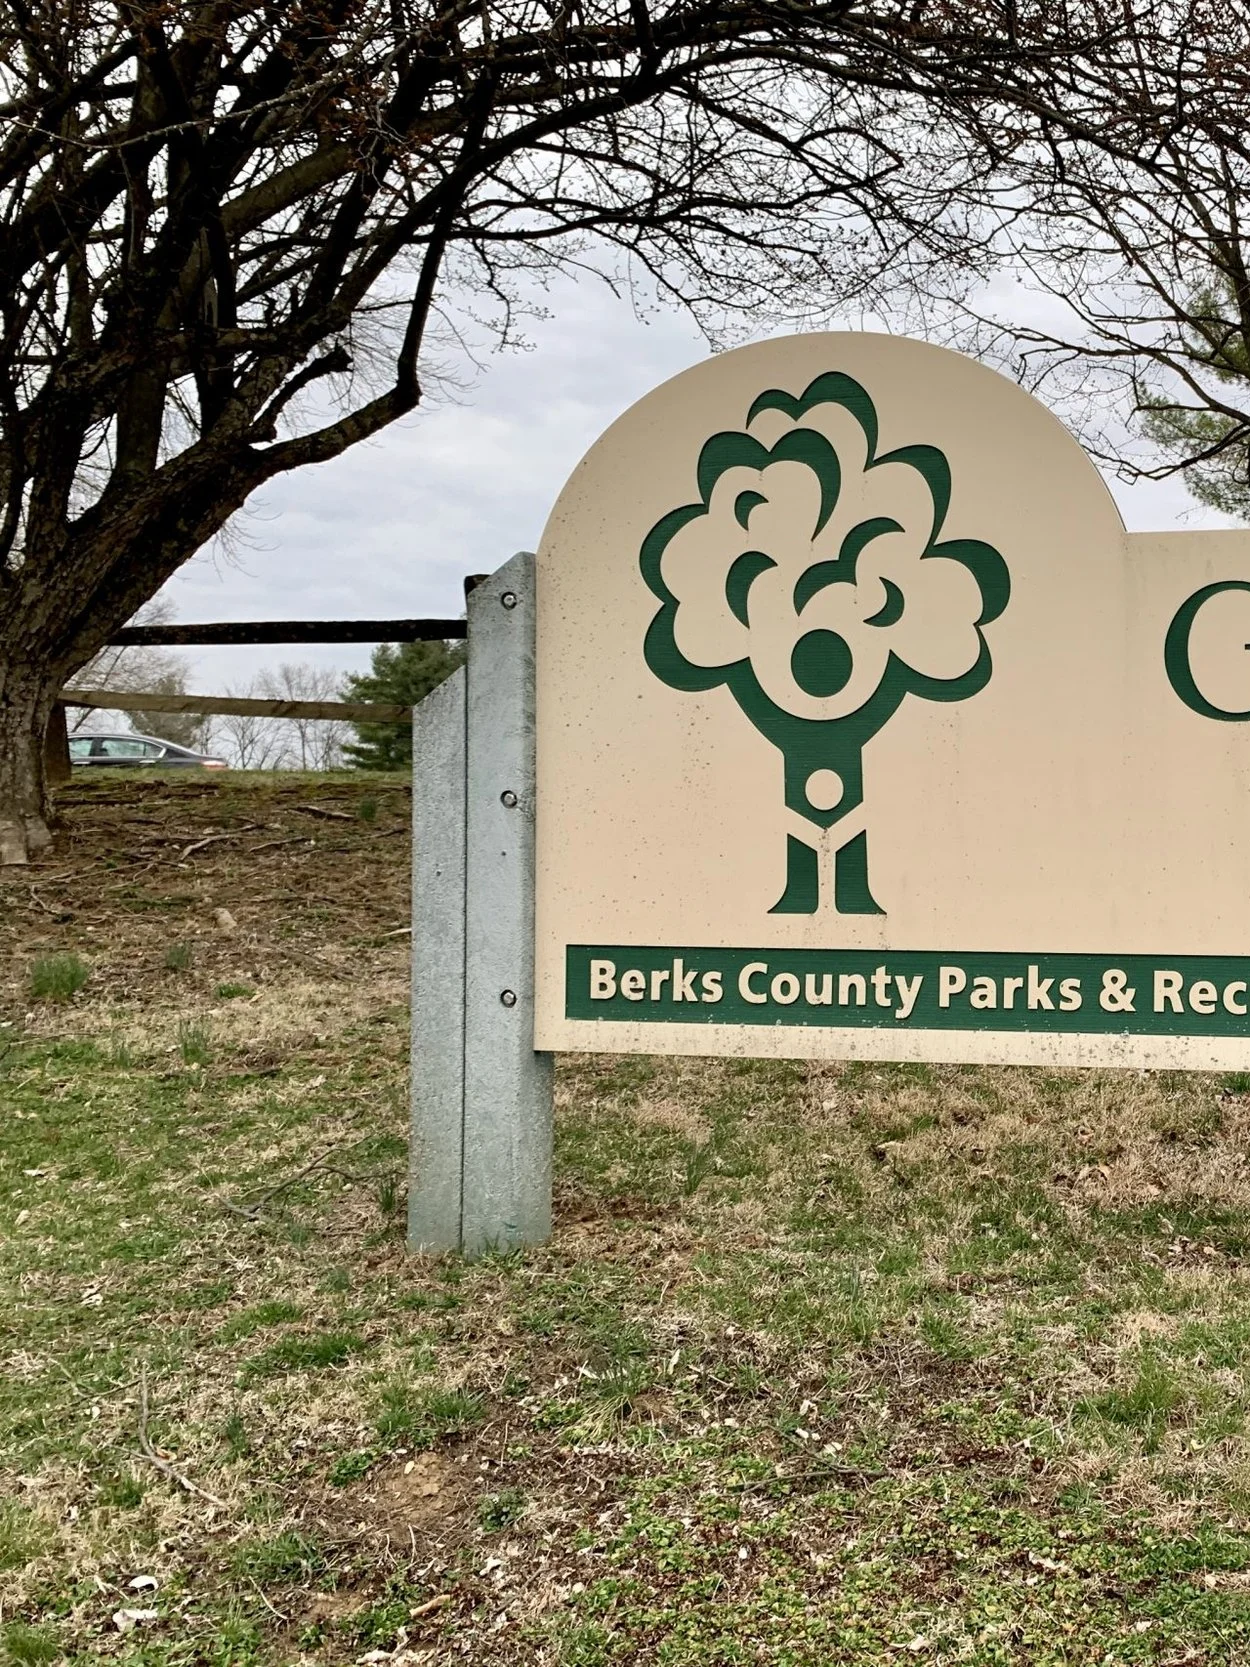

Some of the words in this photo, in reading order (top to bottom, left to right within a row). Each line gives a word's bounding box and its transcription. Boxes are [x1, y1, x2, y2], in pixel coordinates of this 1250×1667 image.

[589, 957, 723, 1003] Berks
[738, 961, 924, 1019] County
[938, 965, 1083, 1011] Parks
[1099, 968, 1136, 1014] &
